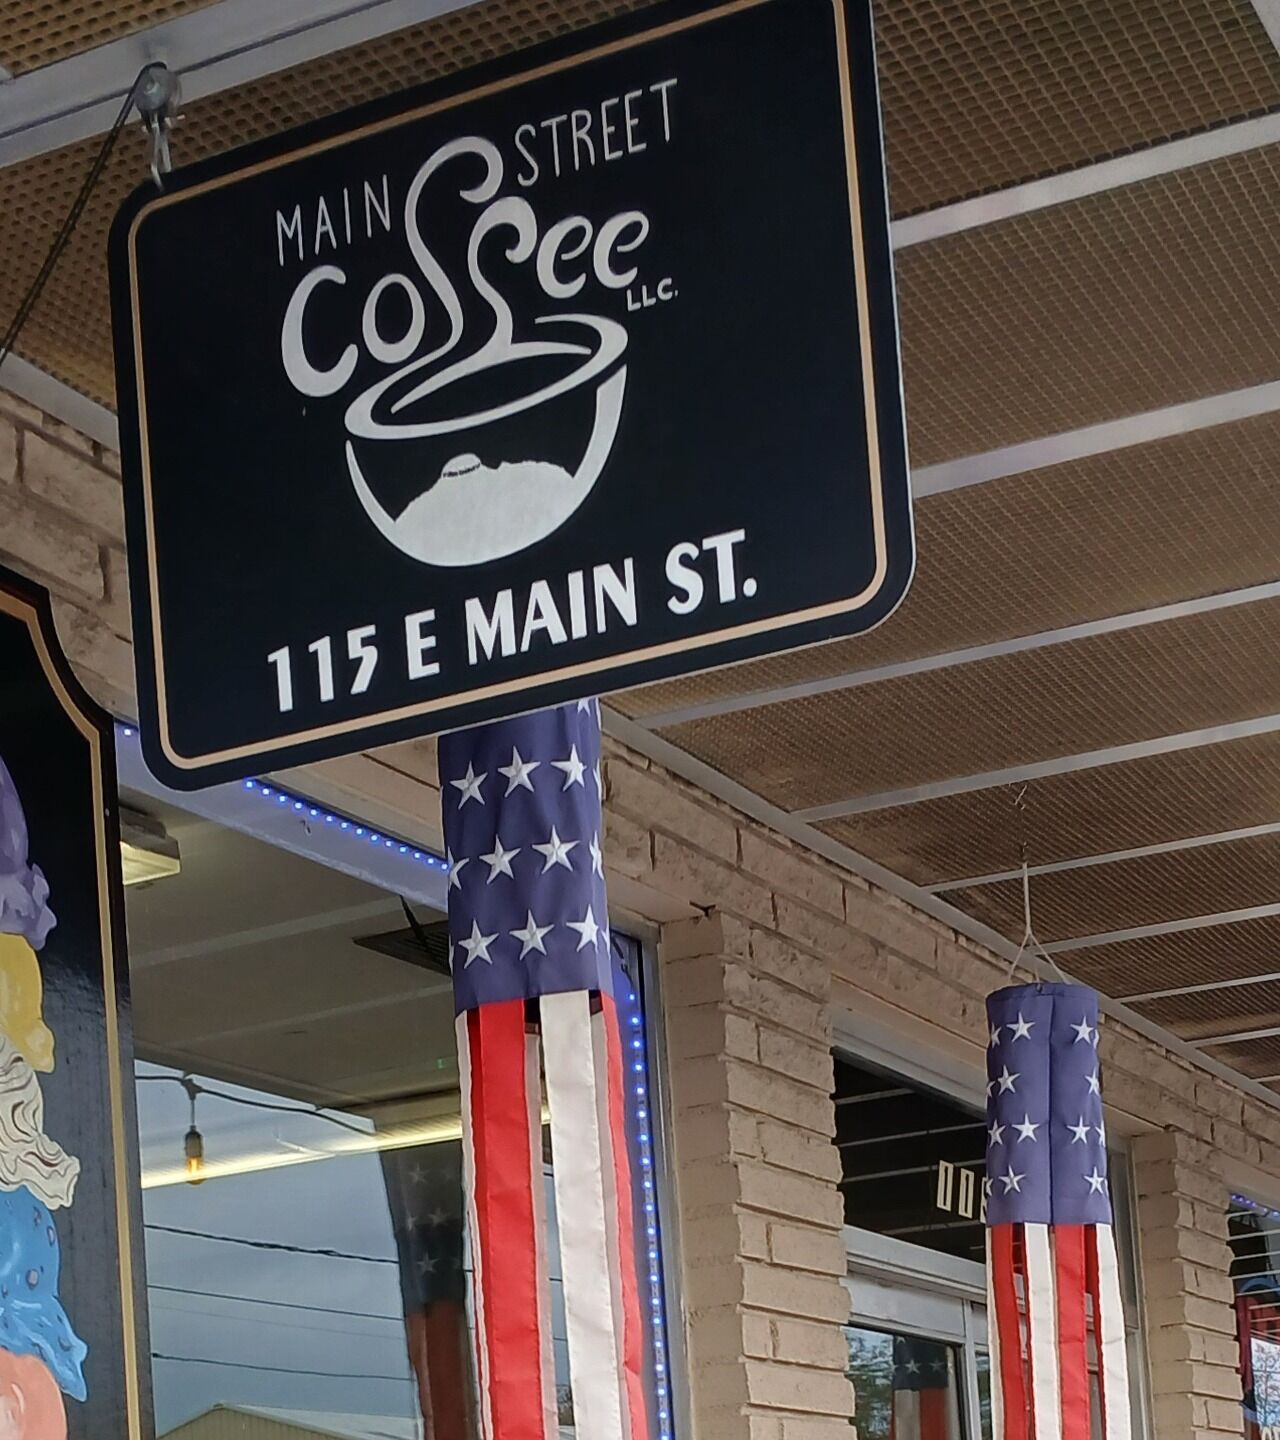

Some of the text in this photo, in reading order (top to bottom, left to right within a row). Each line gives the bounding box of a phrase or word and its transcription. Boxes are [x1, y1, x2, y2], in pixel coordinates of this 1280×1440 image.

[276, 77, 679, 266] MAIN STREET
[280, 135, 650, 398] Coffee
[625, 276, 679, 312] LLC.
[267, 529, 758, 714] 115 E MAIN ST.
